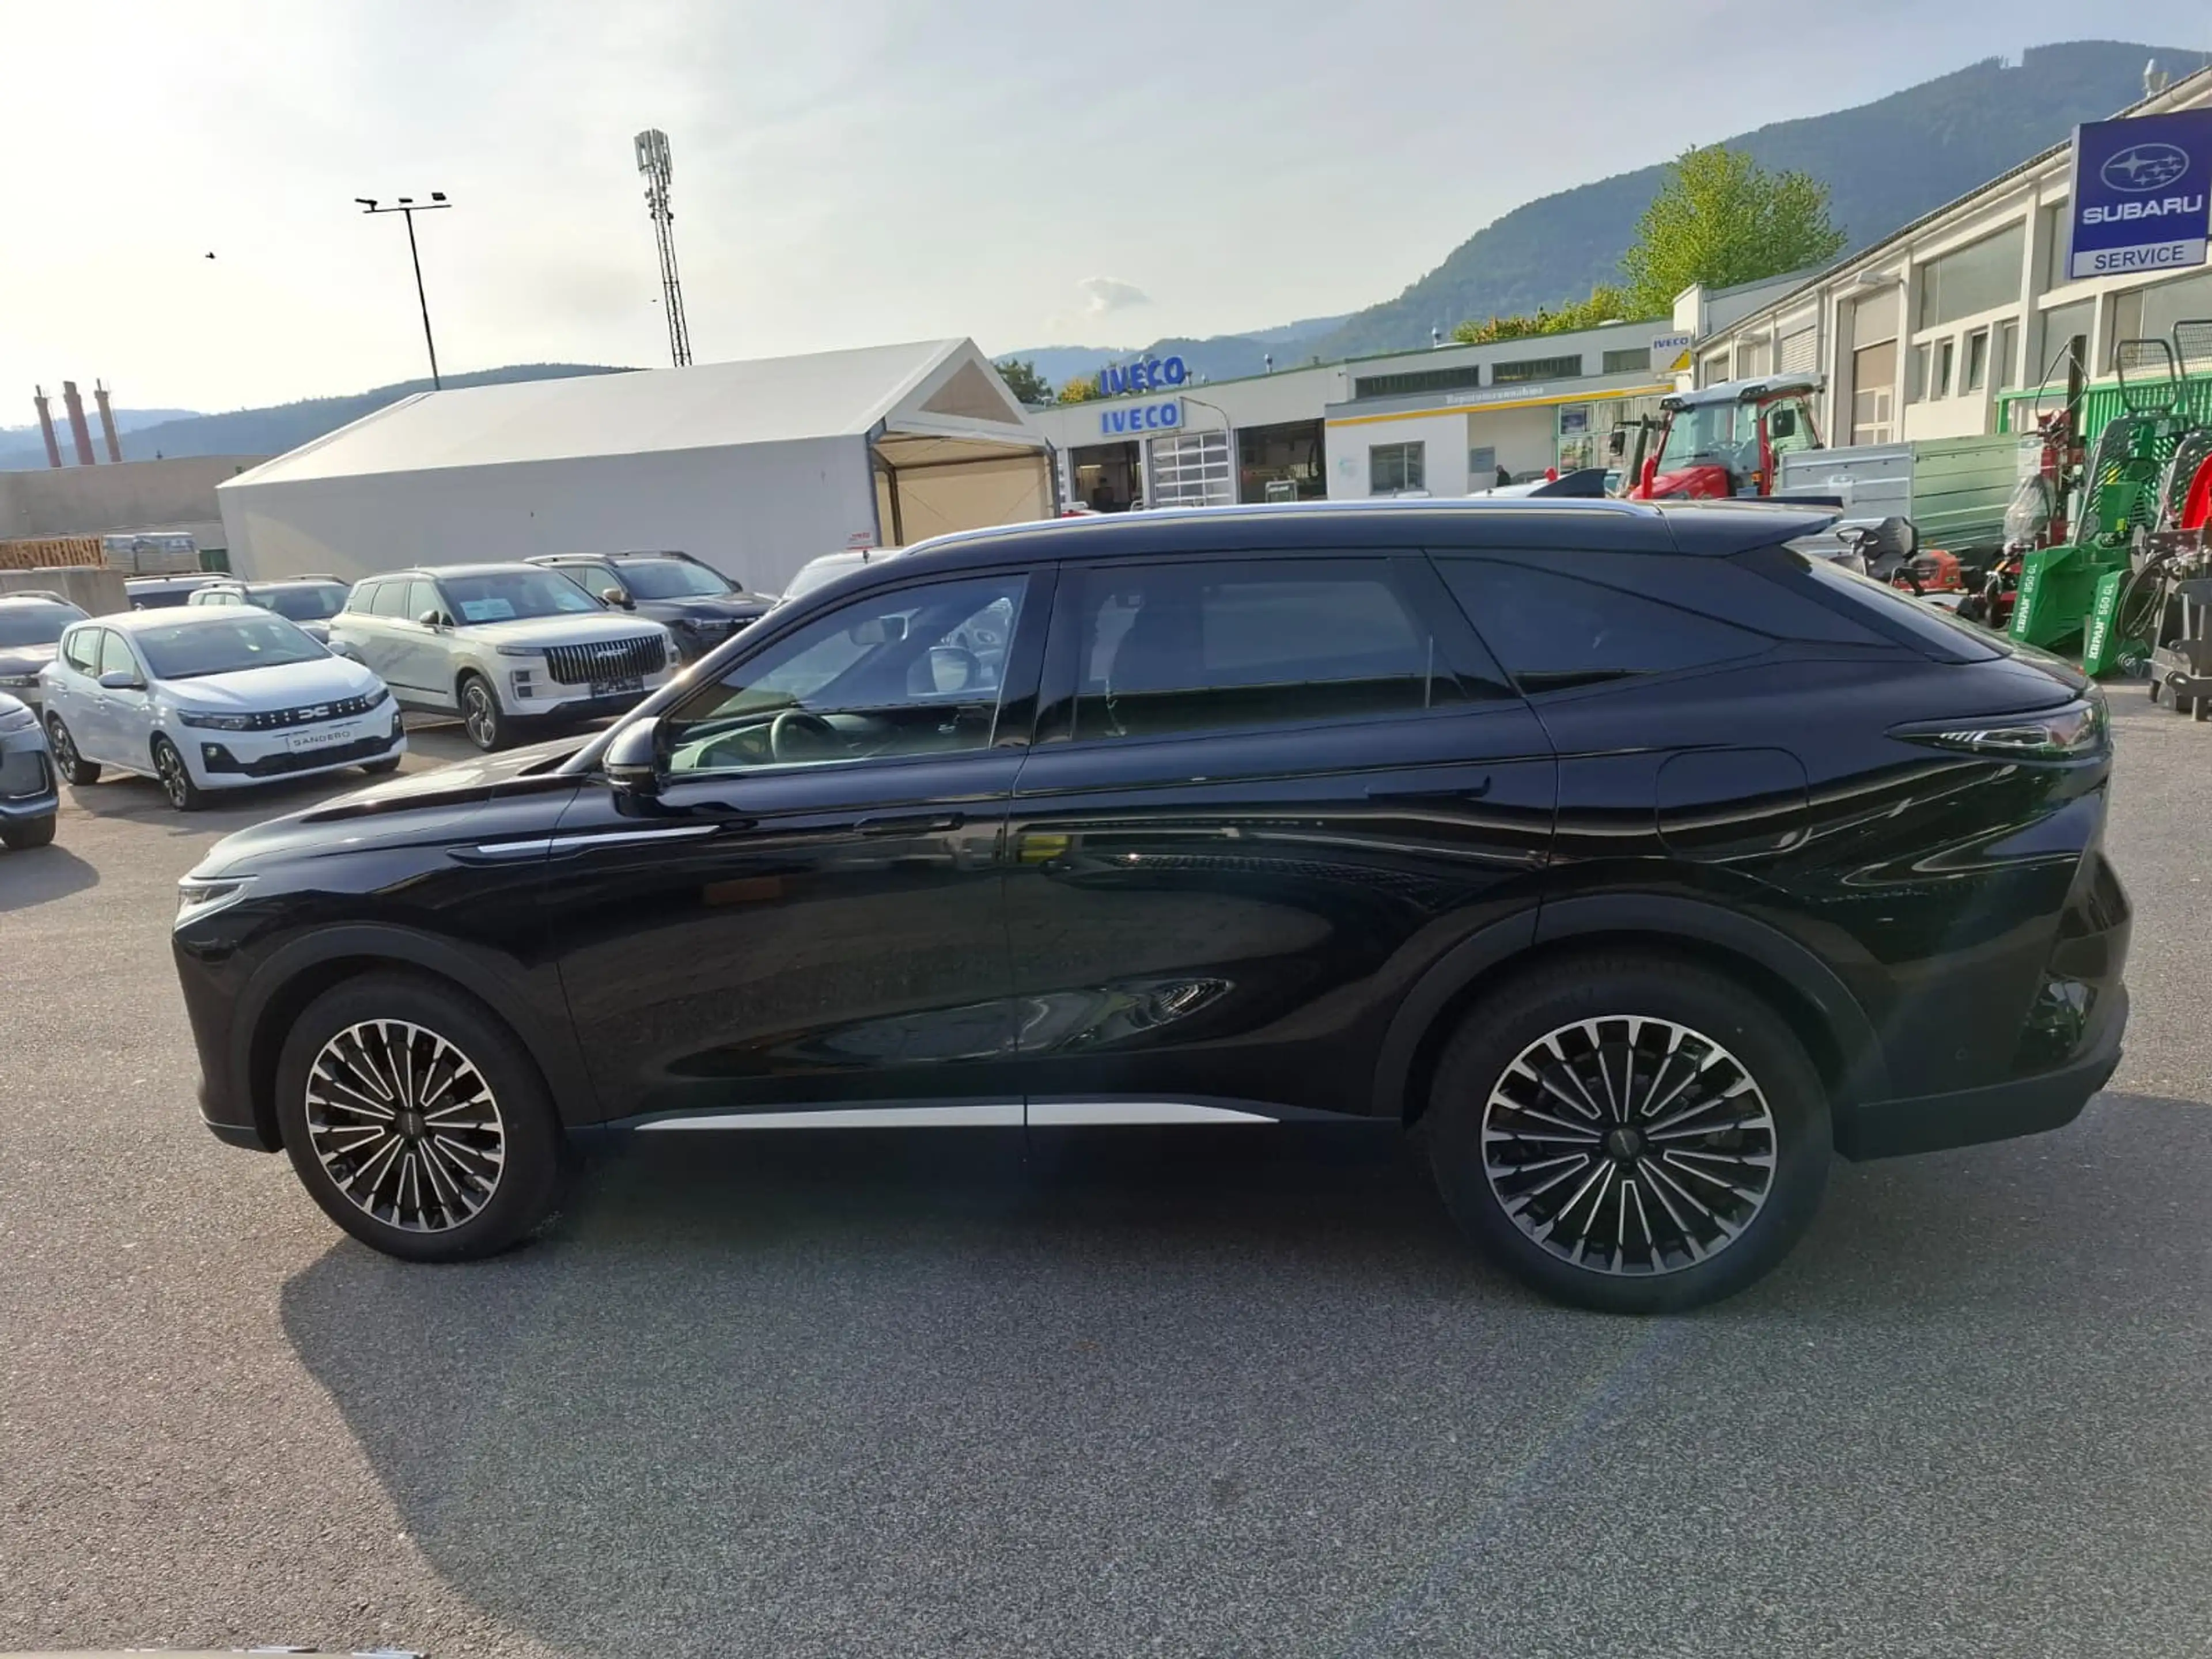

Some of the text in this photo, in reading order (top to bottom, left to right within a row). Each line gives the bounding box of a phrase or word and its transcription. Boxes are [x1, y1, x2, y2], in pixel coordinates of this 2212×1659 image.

[2082, 194, 2203, 225] SUBARU
[2094, 245, 2184, 270] SERVICE
[1654, 337, 1689, 349] IVECO
[1100, 357, 1185, 396] IVECO
[1102, 403, 1177, 434] IVECO
[293, 730, 351, 747] SANDERO
